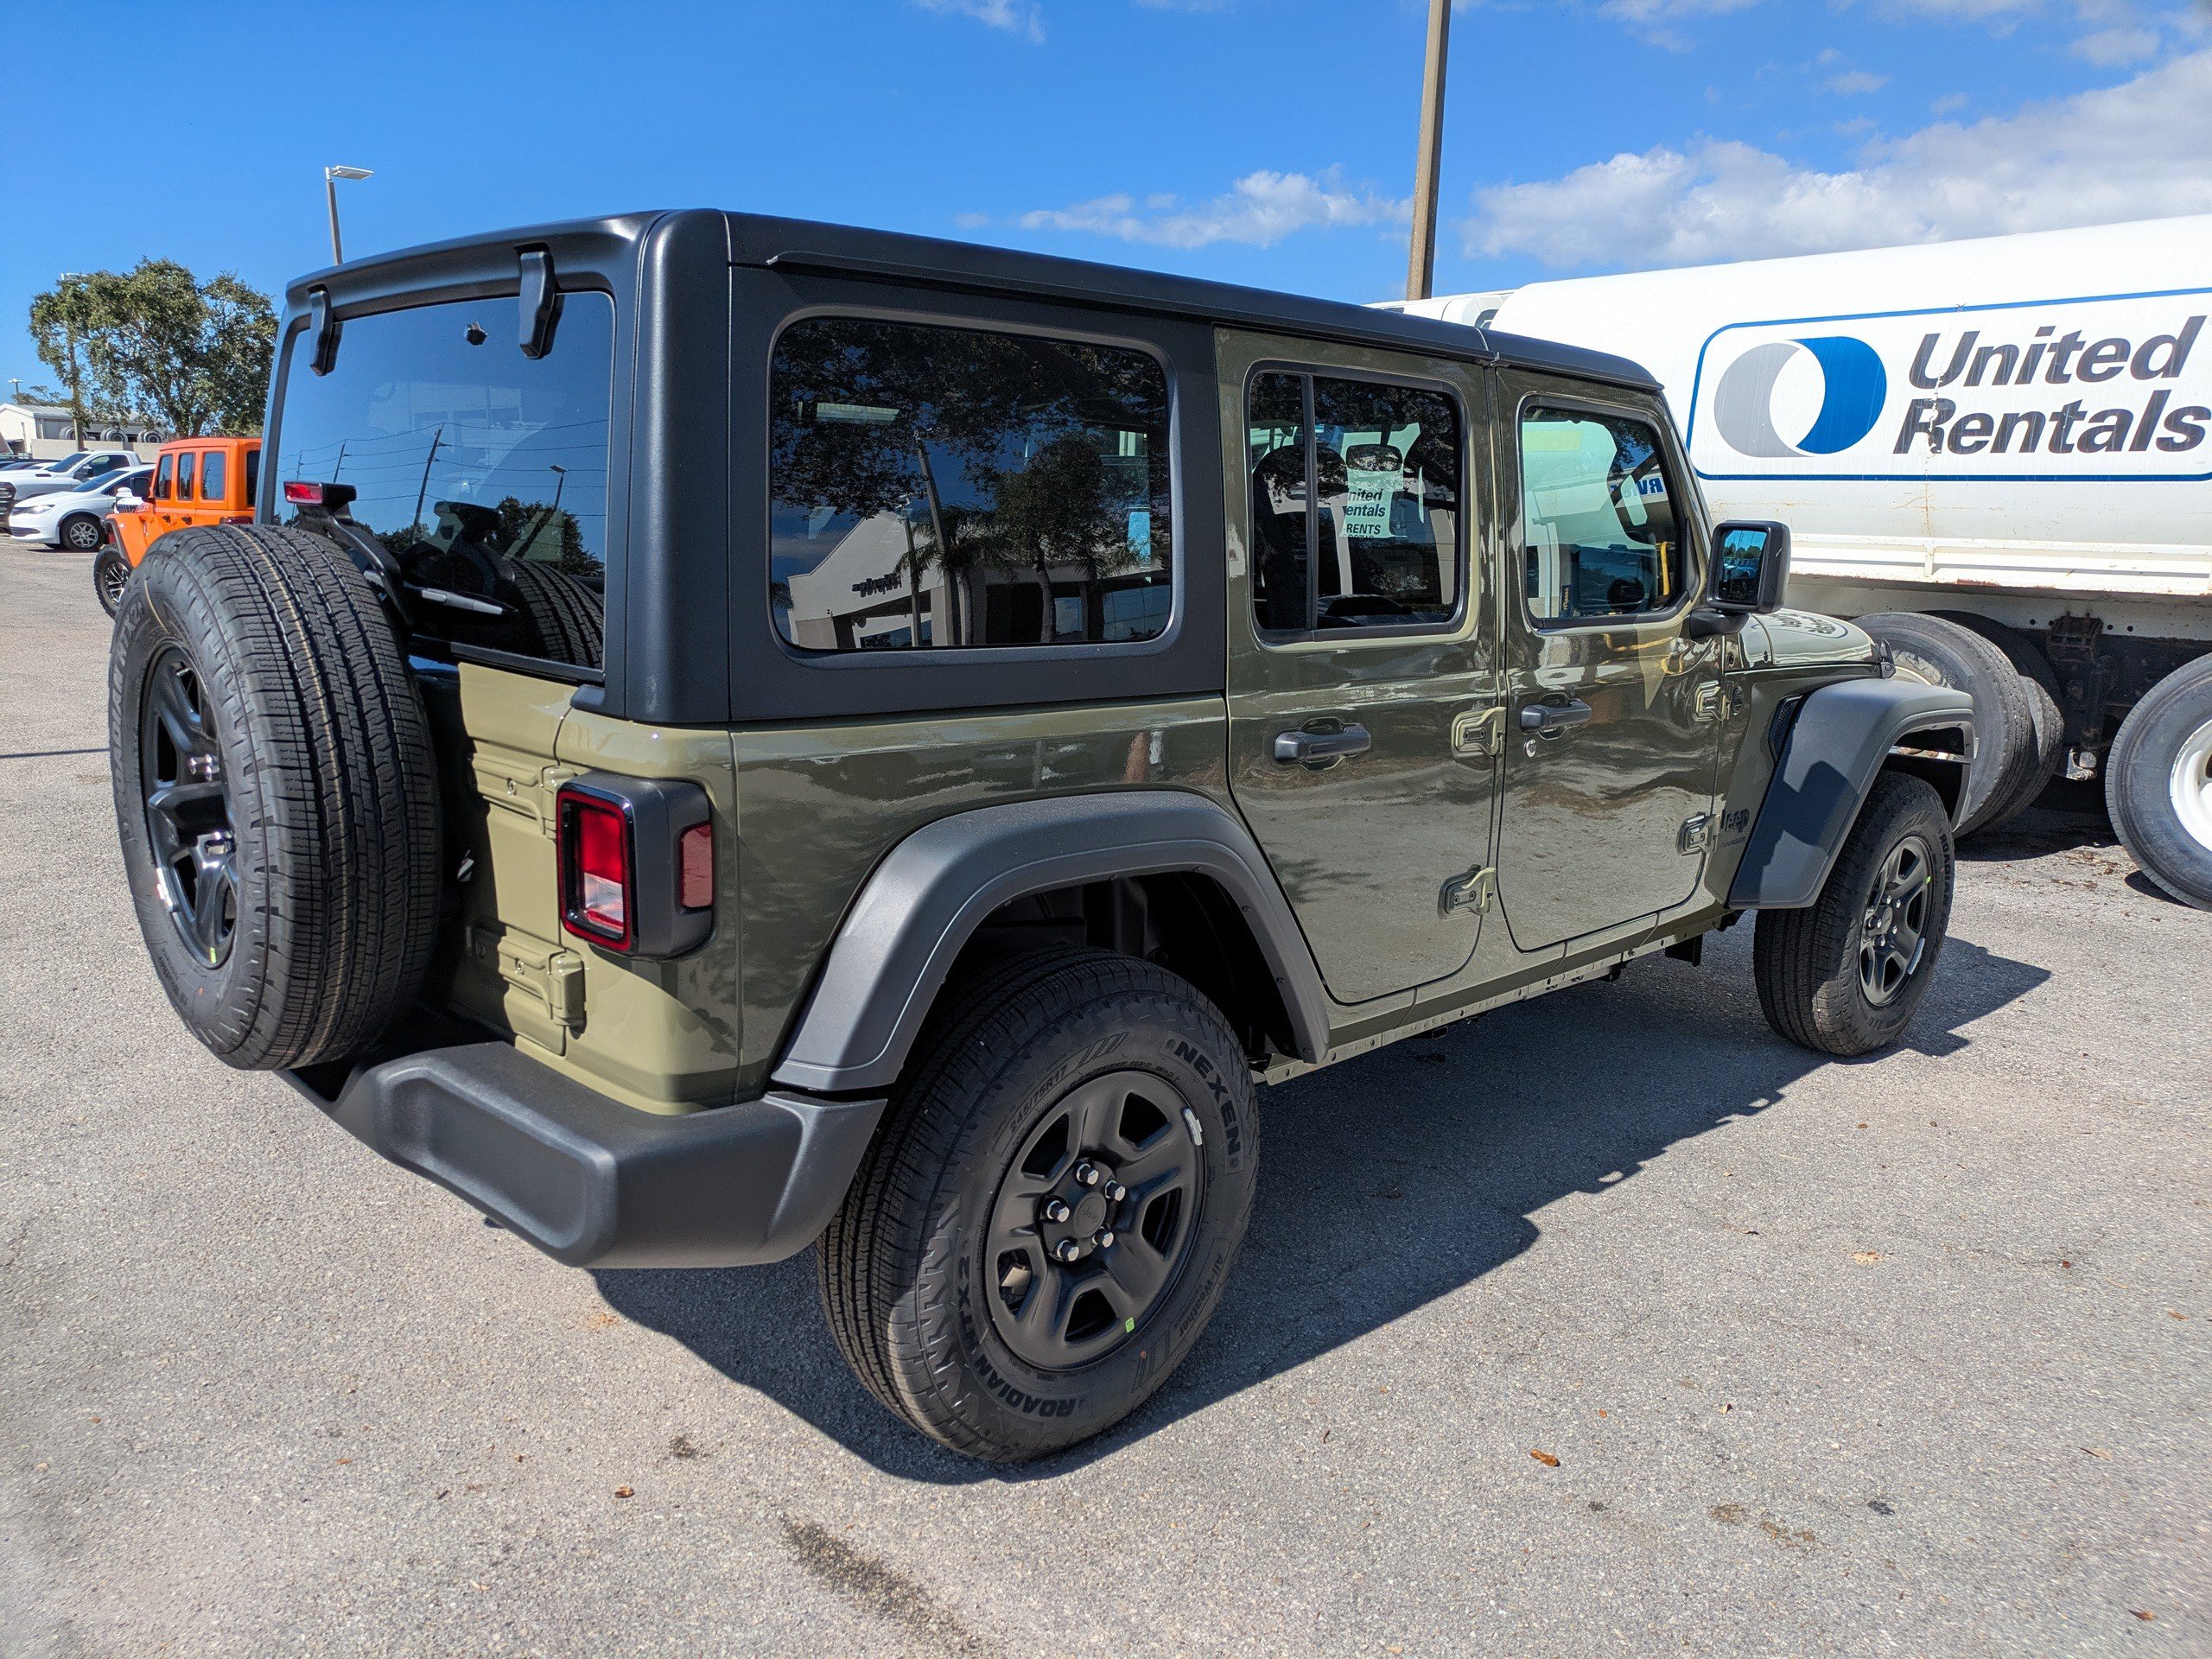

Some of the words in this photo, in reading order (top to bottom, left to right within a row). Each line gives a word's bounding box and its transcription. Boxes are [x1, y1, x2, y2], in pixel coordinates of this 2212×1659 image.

[1908, 315, 2208, 391] United
[1892, 389, 2211, 454] Rentals
[1348, 488, 1383, 501] nited
[1720, 808, 1750, 833] Jeep
[1173, 1040, 1242, 1156] NEXEN
[974, 1353, 1077, 1418] ROADIAN
